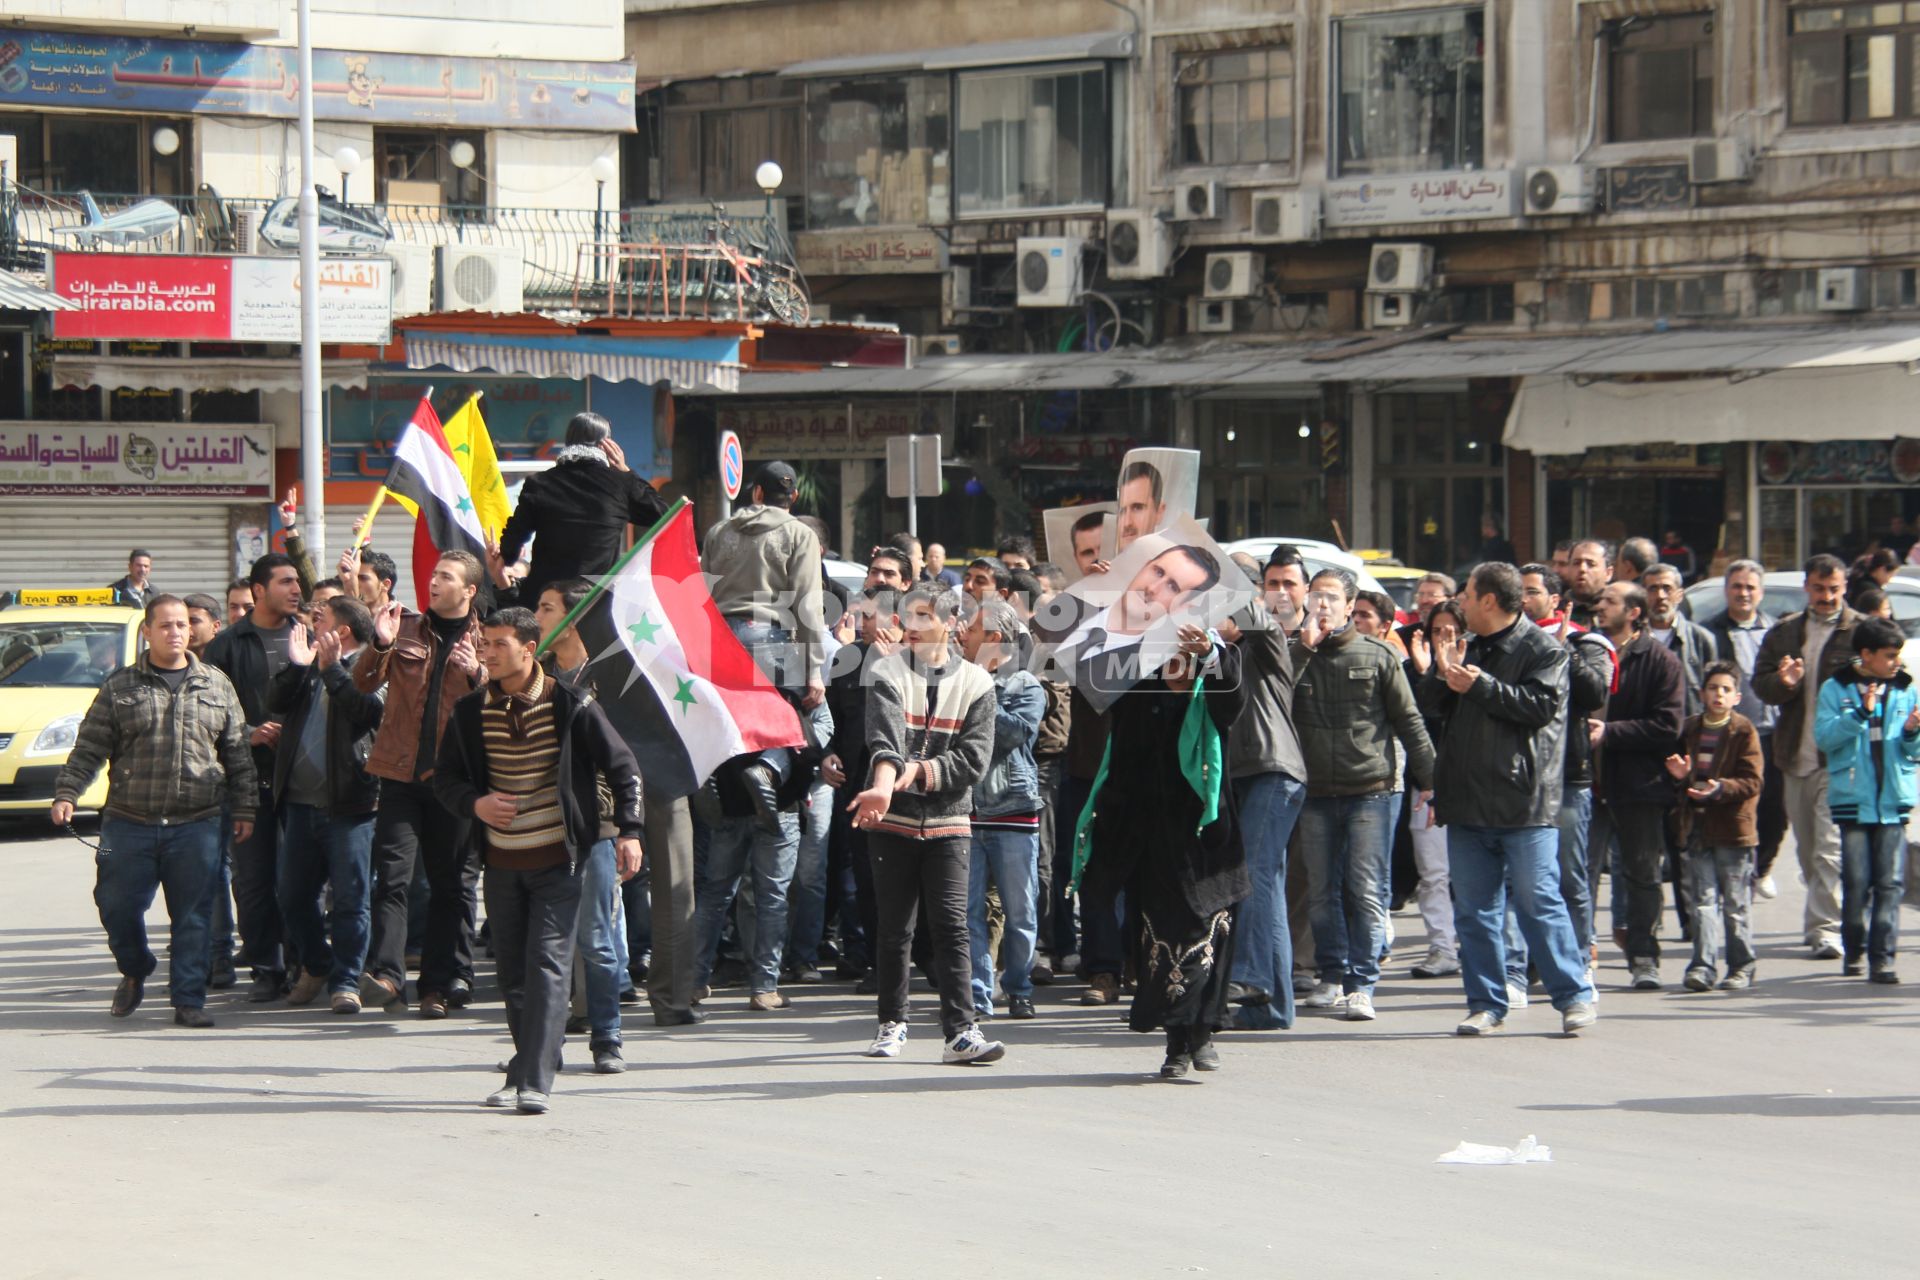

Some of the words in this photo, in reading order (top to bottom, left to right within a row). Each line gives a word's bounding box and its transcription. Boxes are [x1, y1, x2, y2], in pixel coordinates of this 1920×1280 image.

[881, 240, 932, 263] شركة
[69, 280, 146, 296] للطيران
[149, 280, 216, 298] العربية
[70, 294, 216, 313] airarabia.com
[53, 434, 119, 471] للسياحة
[162, 436, 244, 472] القبلتين
[24, 596, 50, 604] TAXI
